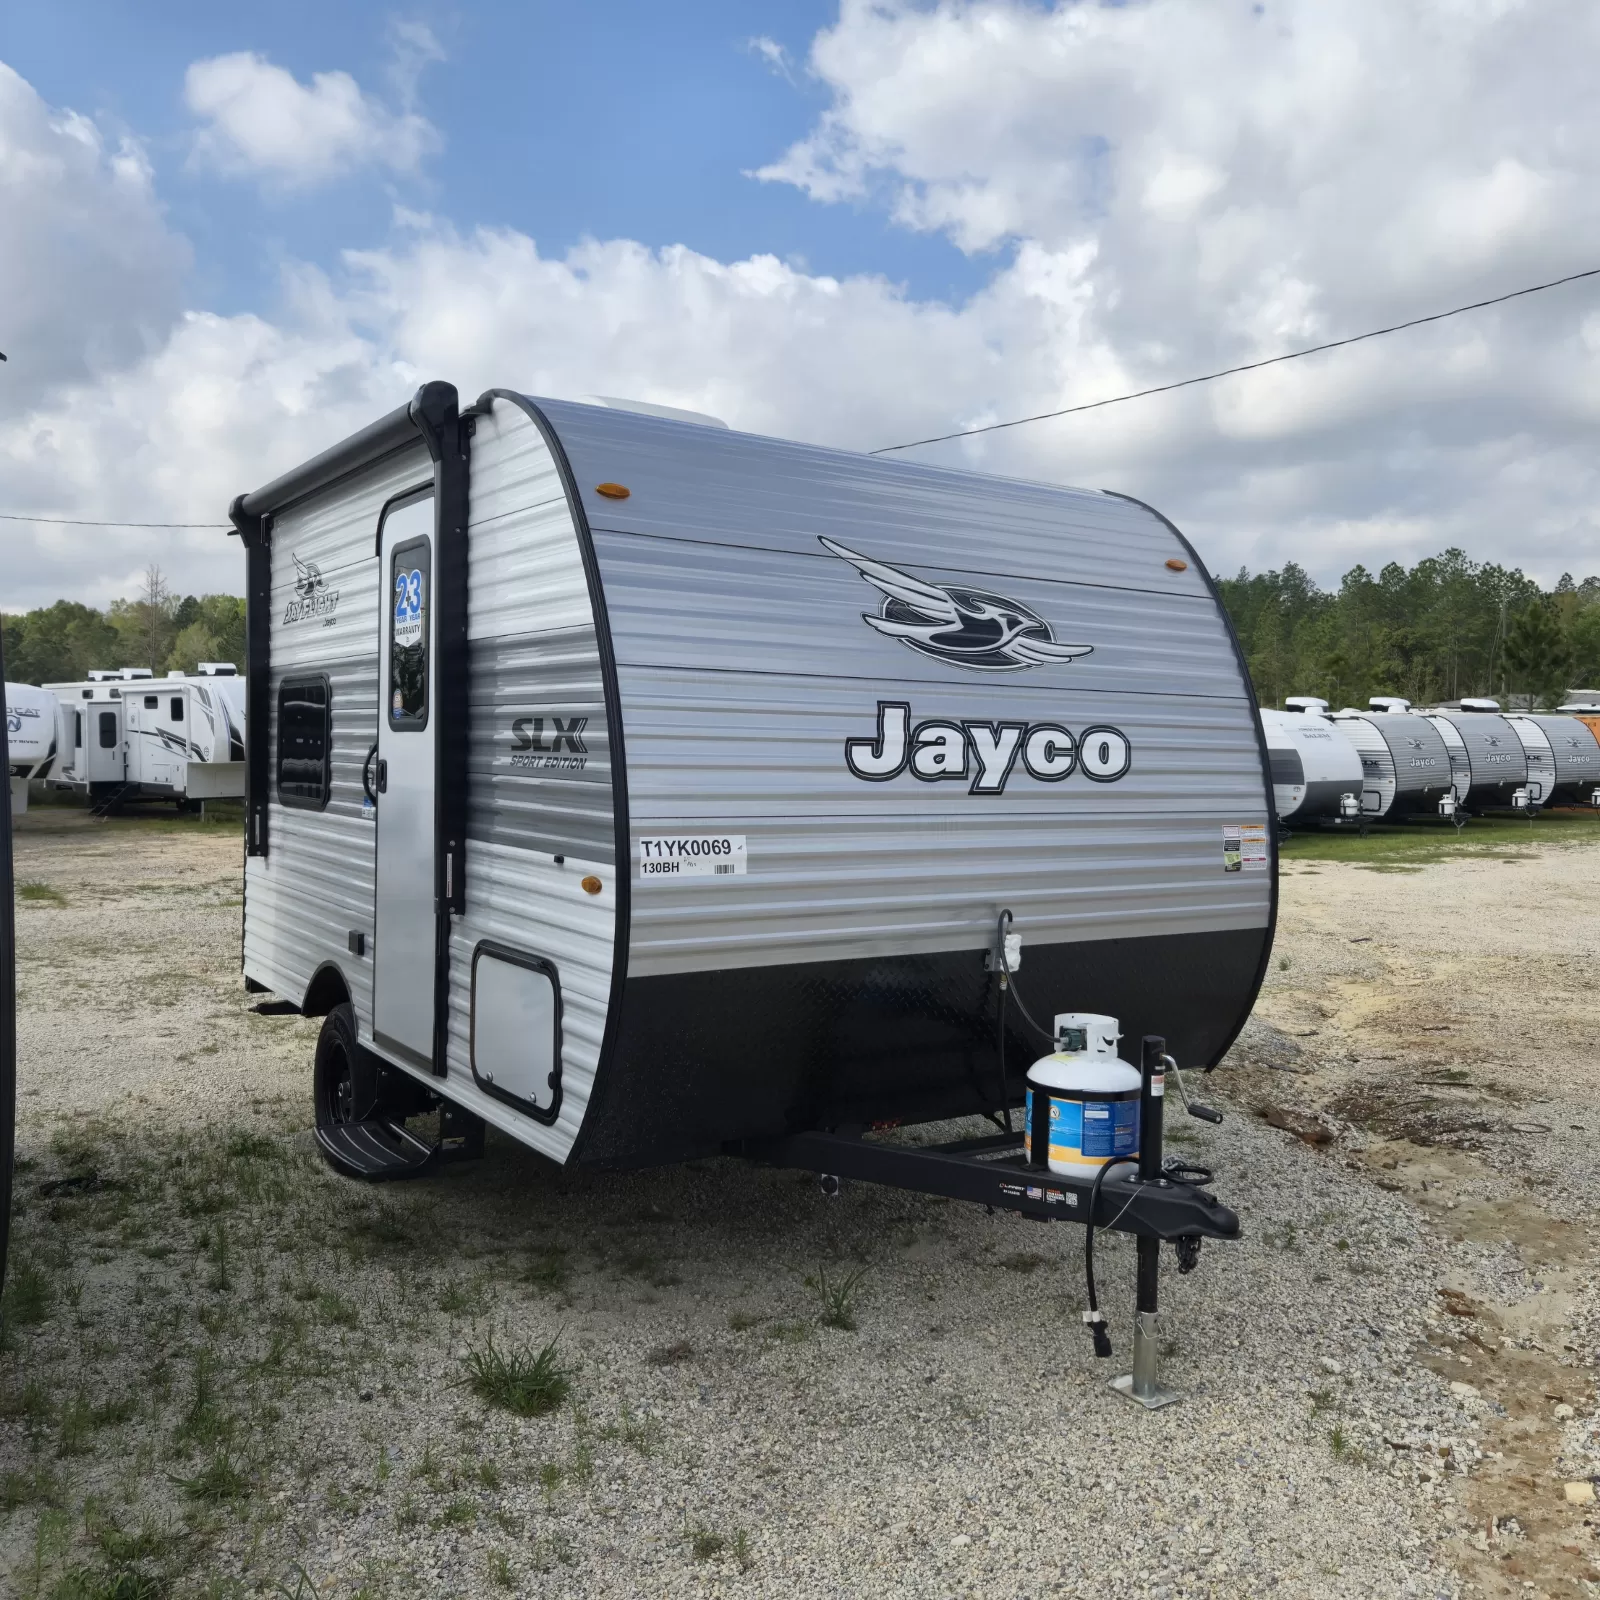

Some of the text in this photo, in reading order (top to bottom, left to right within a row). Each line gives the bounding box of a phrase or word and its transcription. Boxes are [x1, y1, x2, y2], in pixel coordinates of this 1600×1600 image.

[396, 624, 421, 636] WARRANTY
[511, 717, 589, 753] SLX
[844, 700, 1131, 796] Jayco
[510, 755, 588, 770] SPORT EDITION
[1410, 757, 1436, 768] Jayco
[1485, 753, 1511, 764] Jayco
[1567, 754, 1590, 764] Jayco
[641, 839, 732, 857] T1YK0069
[642, 862, 680, 874] 130BH
